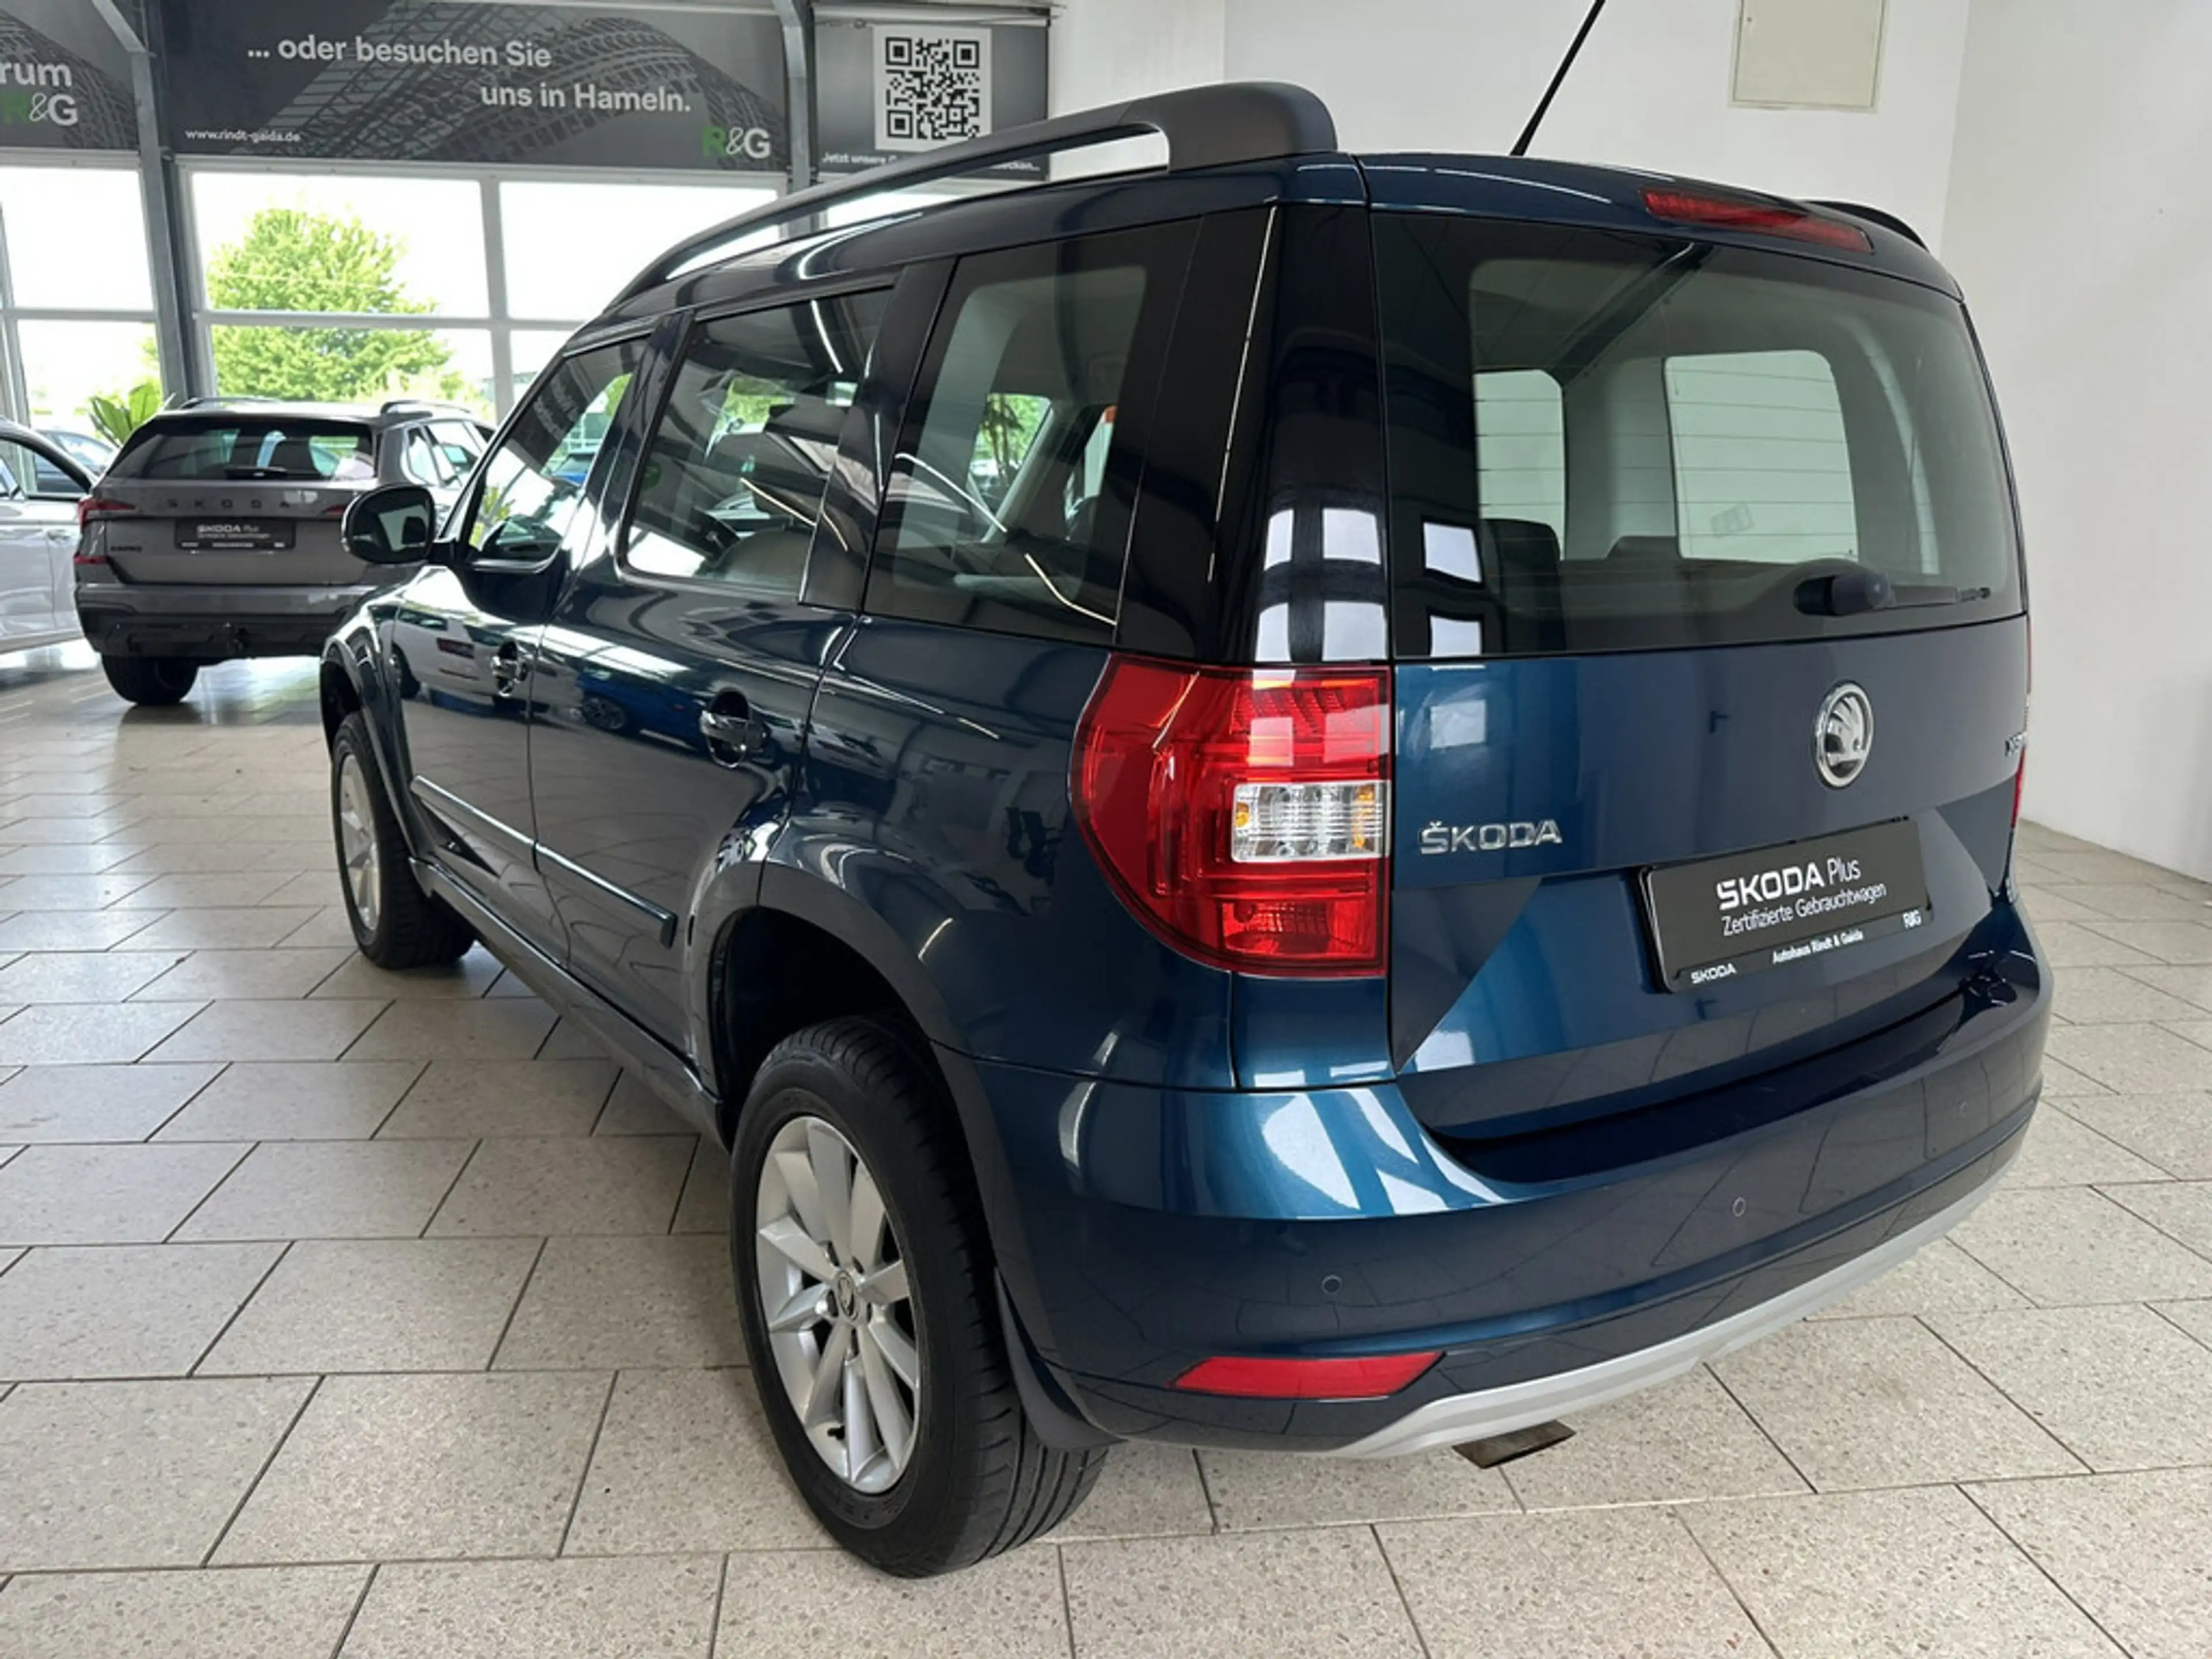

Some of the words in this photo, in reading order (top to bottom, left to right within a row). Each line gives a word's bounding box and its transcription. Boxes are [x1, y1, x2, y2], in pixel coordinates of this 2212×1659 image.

[278, 34, 347, 60] oder
[355, 35, 497, 66] besuchen
[506, 40, 552, 67] Sie
[480, 85, 533, 107] uns
[540, 82, 566, 108] in
[574, 83, 691, 112] Hameln.
[702, 126, 771, 160] R&G
[1419, 819, 1563, 855] ŠKODA
[1827, 857, 1861, 885] Plus
[1721, 904, 1794, 937] Zertifizierte
[1795, 882, 1887, 917] Gebrauchtwagen
[1772, 945, 1812, 964] Autohaus
